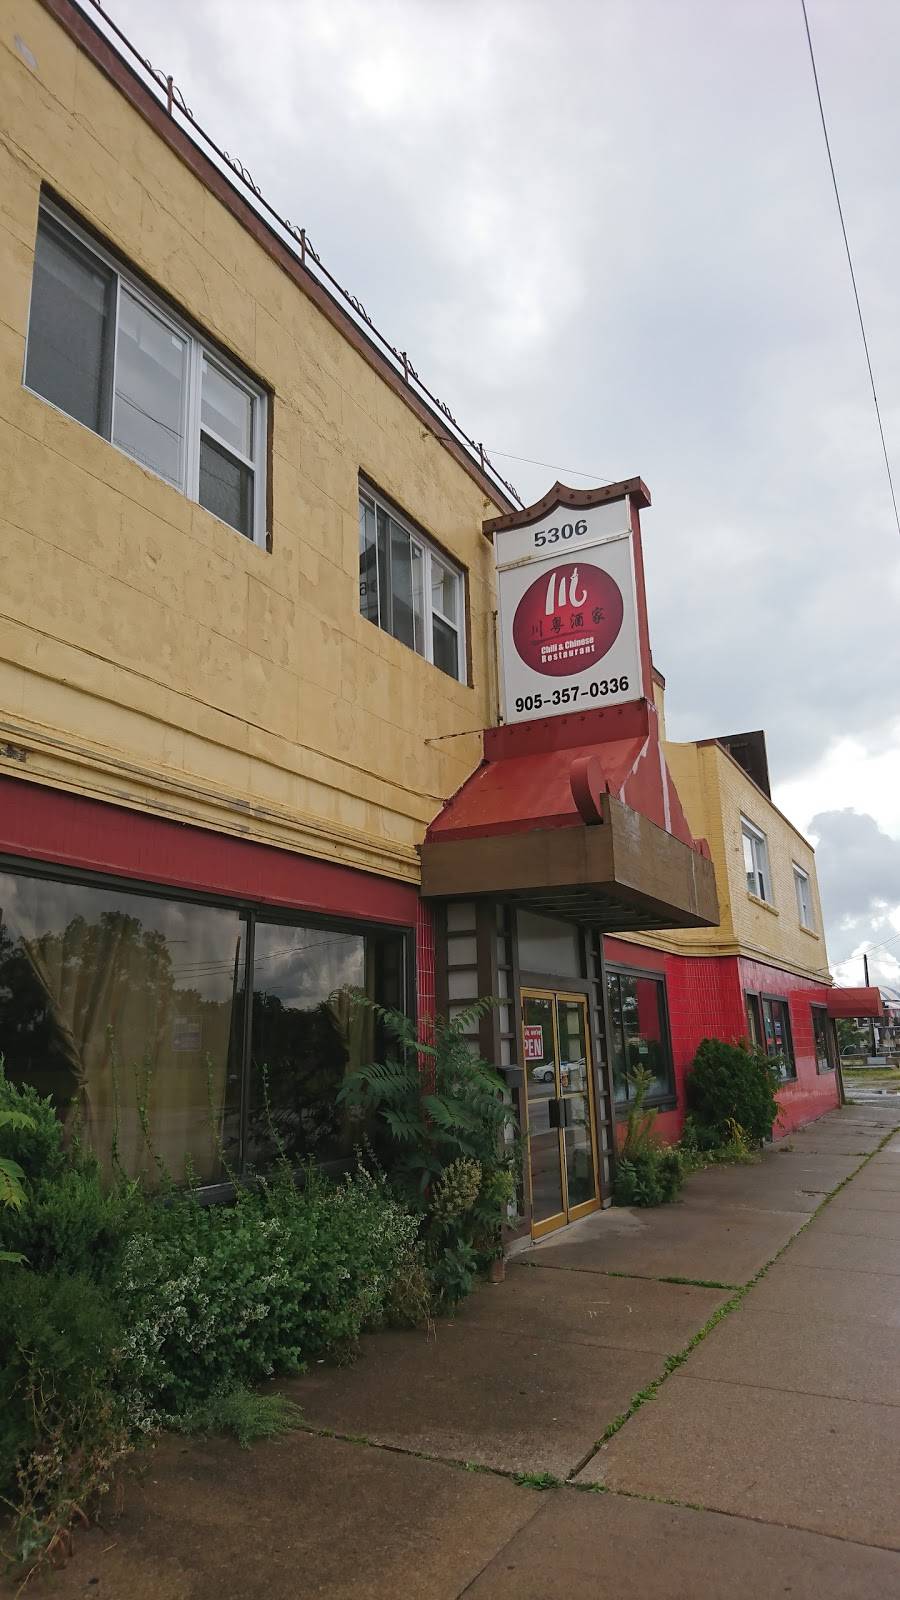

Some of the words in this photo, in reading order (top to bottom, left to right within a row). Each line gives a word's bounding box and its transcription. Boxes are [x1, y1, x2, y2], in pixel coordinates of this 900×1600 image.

[534, 519, 588, 547] 5306
[541, 644, 558, 654] Chili
[558, 643, 564, 651] &
[564, 637, 594, 649] Chinese
[541, 645, 595, 663] Restaurant
[515, 676, 629, 712] 905-357-0336
[524, 1039, 542, 1057] PEN
